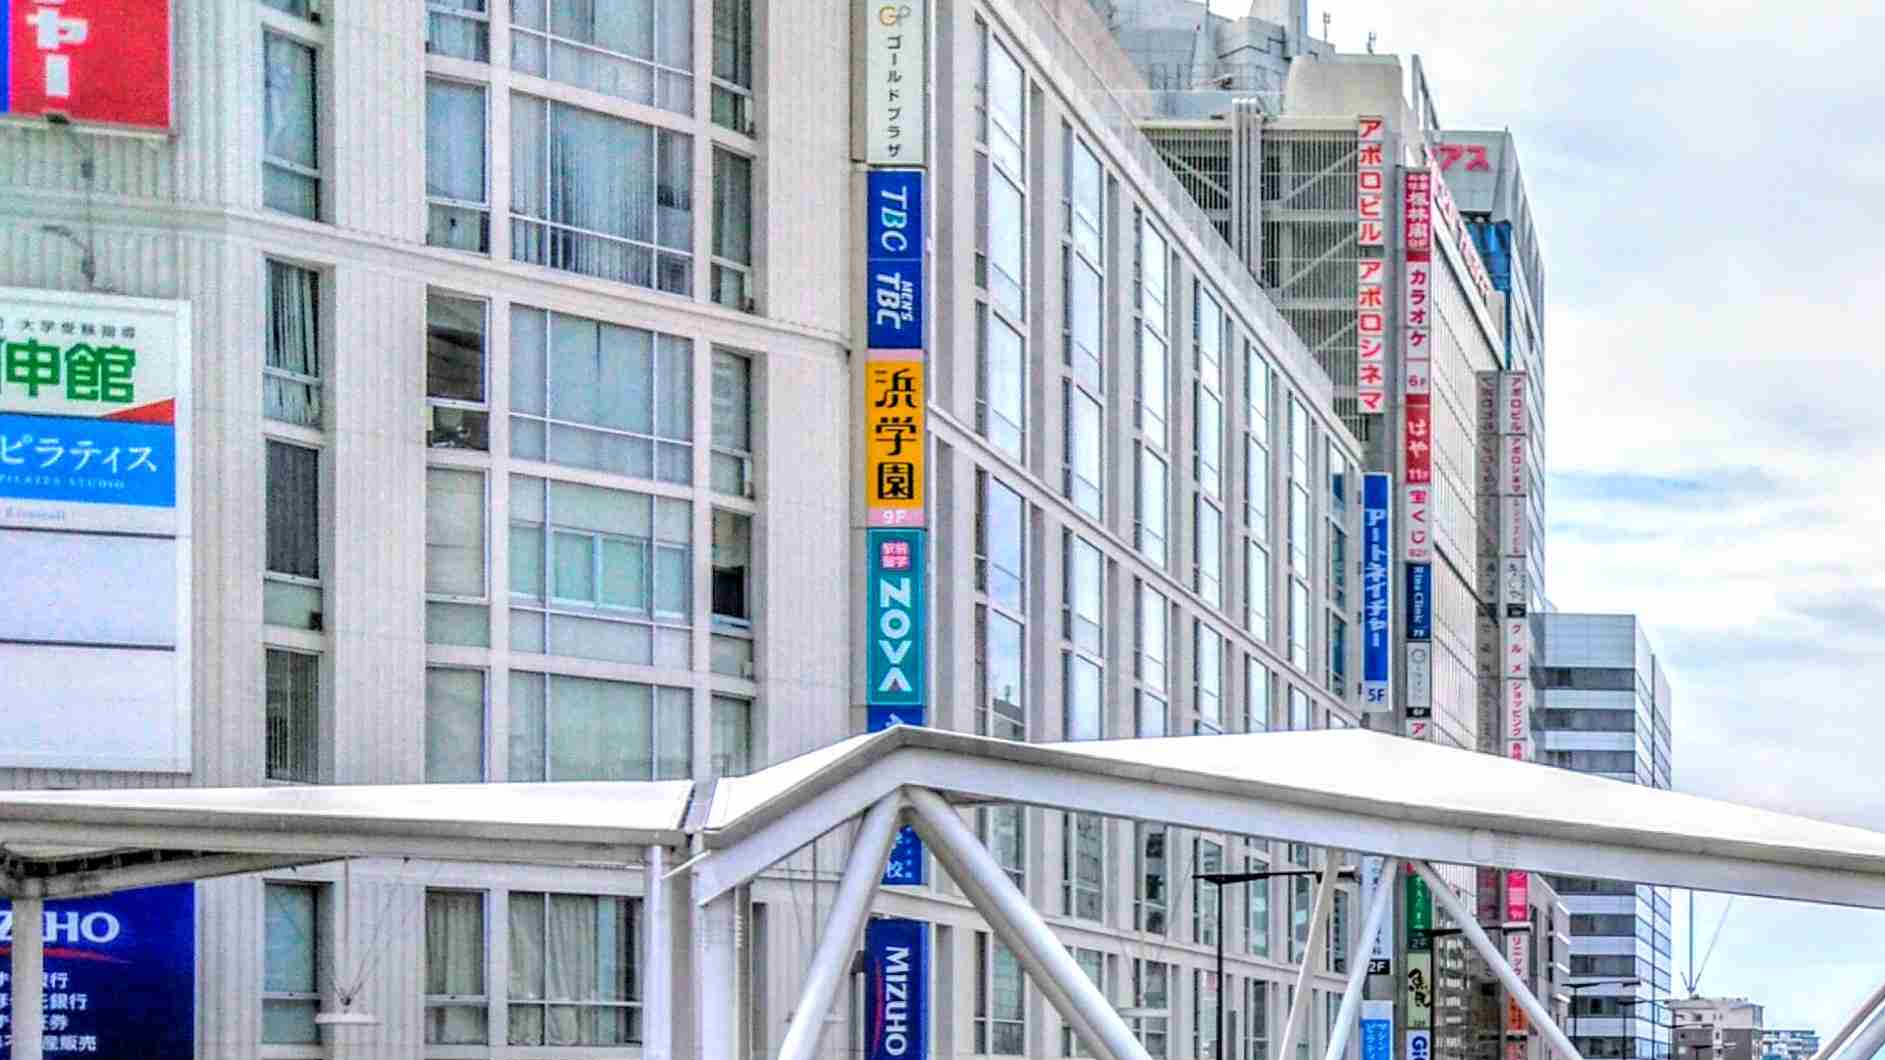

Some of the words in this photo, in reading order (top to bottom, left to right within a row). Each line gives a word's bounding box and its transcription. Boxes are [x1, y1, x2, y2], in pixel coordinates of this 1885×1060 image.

[887, 35, 902, 158] ゴールドプラザ
[881, 186, 908, 252] TBC
[1358, 118, 1382, 243] アポロビル
[876, 273, 901, 330] TBC
[1358, 261, 1382, 411] アポロシネマ
[1410, 270, 1427, 347] カラオケ
[0, 434, 157, 474] ピラティス
[875, 369, 917, 500] 浜学園
[883, 510, 906, 524] 9F
[878, 577, 912, 692] NOVA
[1367, 688, 1385, 702] 5F
[885, 946, 909, 1056] MIZUHO
[1369, 960, 1386, 973] 2F
